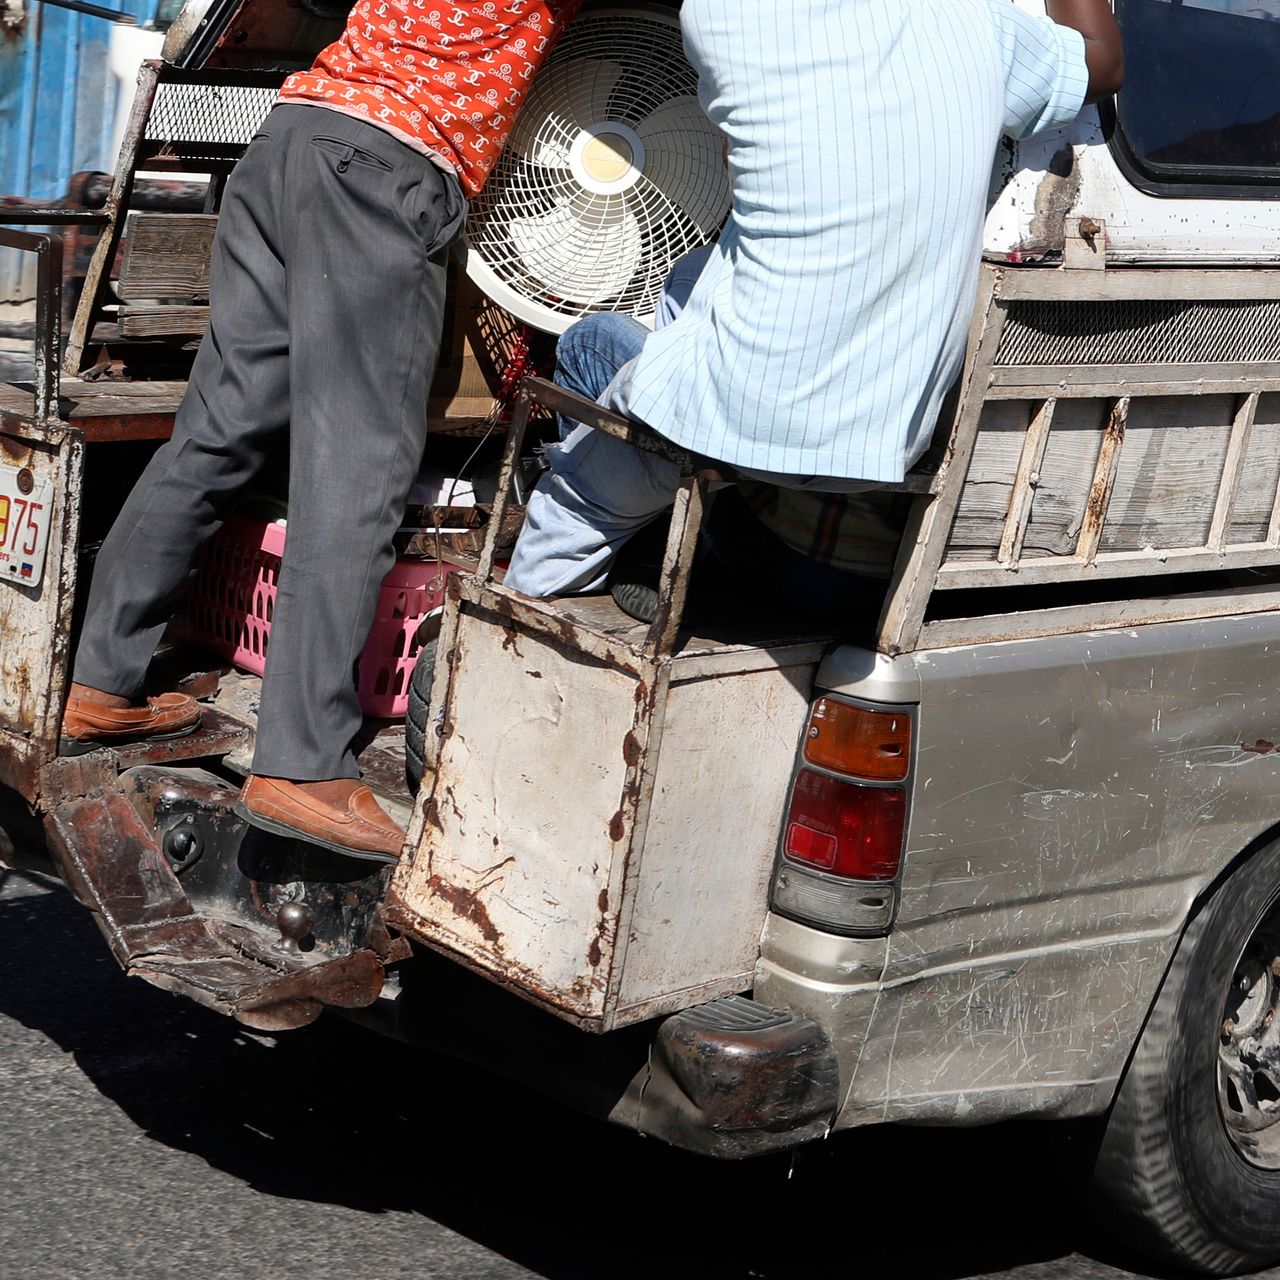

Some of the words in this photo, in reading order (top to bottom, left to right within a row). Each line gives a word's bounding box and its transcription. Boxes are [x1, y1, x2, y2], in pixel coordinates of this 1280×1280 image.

[472, 7, 498, 21] CHANEL
[418, 16, 442, 30] CHANEL
[518, 20, 542, 32] CHANEL
[458, 32, 485, 46] CHANEL
[502, 44, 528, 58] CHANEL
[395, 60, 418, 73] CHANEL
[432, 74, 458, 90] CHANEL
[488, 68, 513, 84] CHANEL
[475, 92, 500, 110] CHANEL
[400, 110, 422, 134] CHANEL
[460, 113, 482, 131] CHANEL
